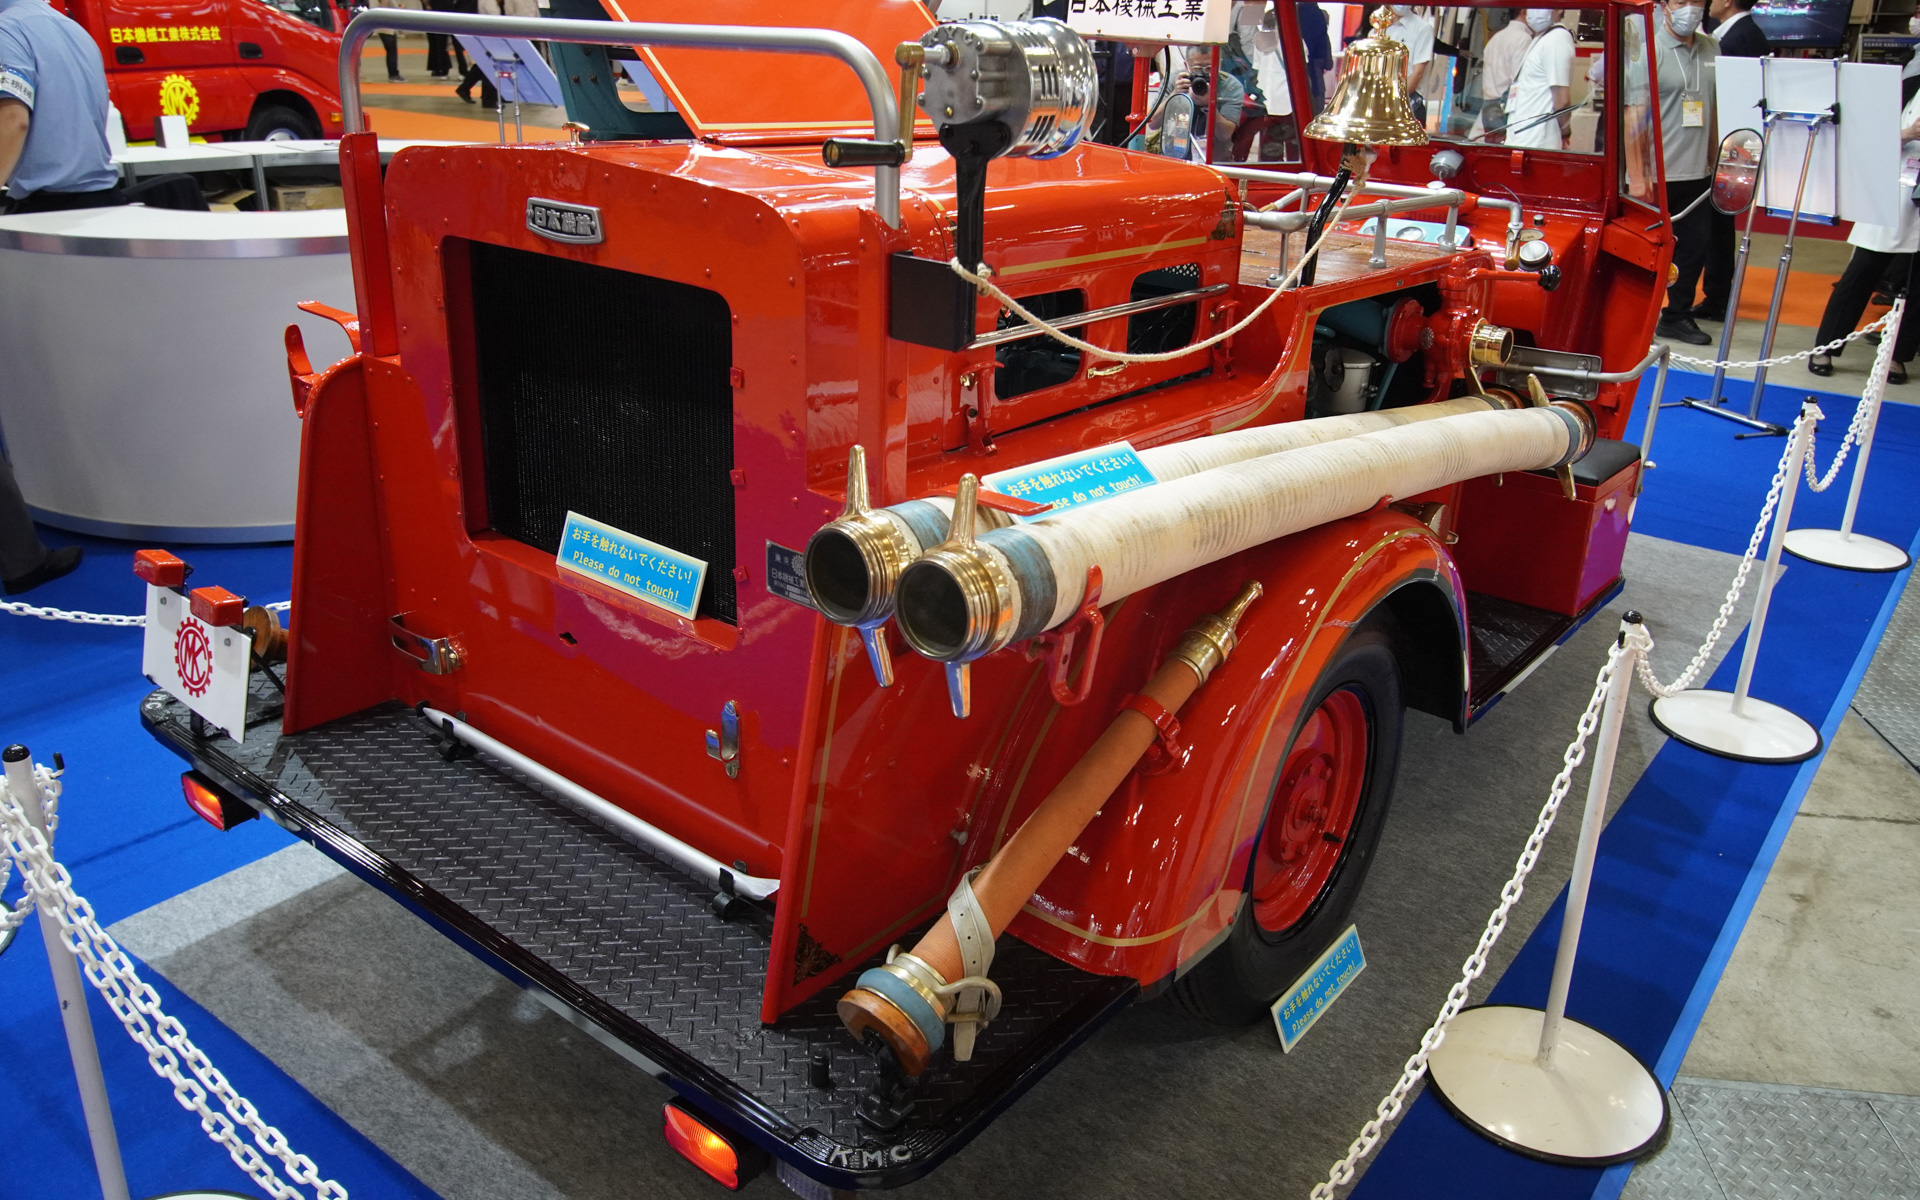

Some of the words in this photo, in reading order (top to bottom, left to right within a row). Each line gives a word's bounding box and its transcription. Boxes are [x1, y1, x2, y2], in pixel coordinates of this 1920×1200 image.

[110, 26, 221, 43] 日本機械工業株式会社
[534, 206, 593, 236] 日本機械
[1073, 491, 1087, 503] do
[1089, 485, 1109, 498] not
[1109, 474, 1144, 492] touch!
[572, 527, 692, 584] お手を触れないでください!
[573, 550, 604, 572] Please
[608, 565, 620, 578] do
[624, 572, 641, 588] not
[646, 580, 679, 602] touch!
[1291, 1008, 1314, 1034] Please
[1315, 997, 1324, 1009] do
[1324, 984, 1336, 998] not
[1336, 960, 1356, 985] touch!
[829, 1144, 913, 1168] KMC
